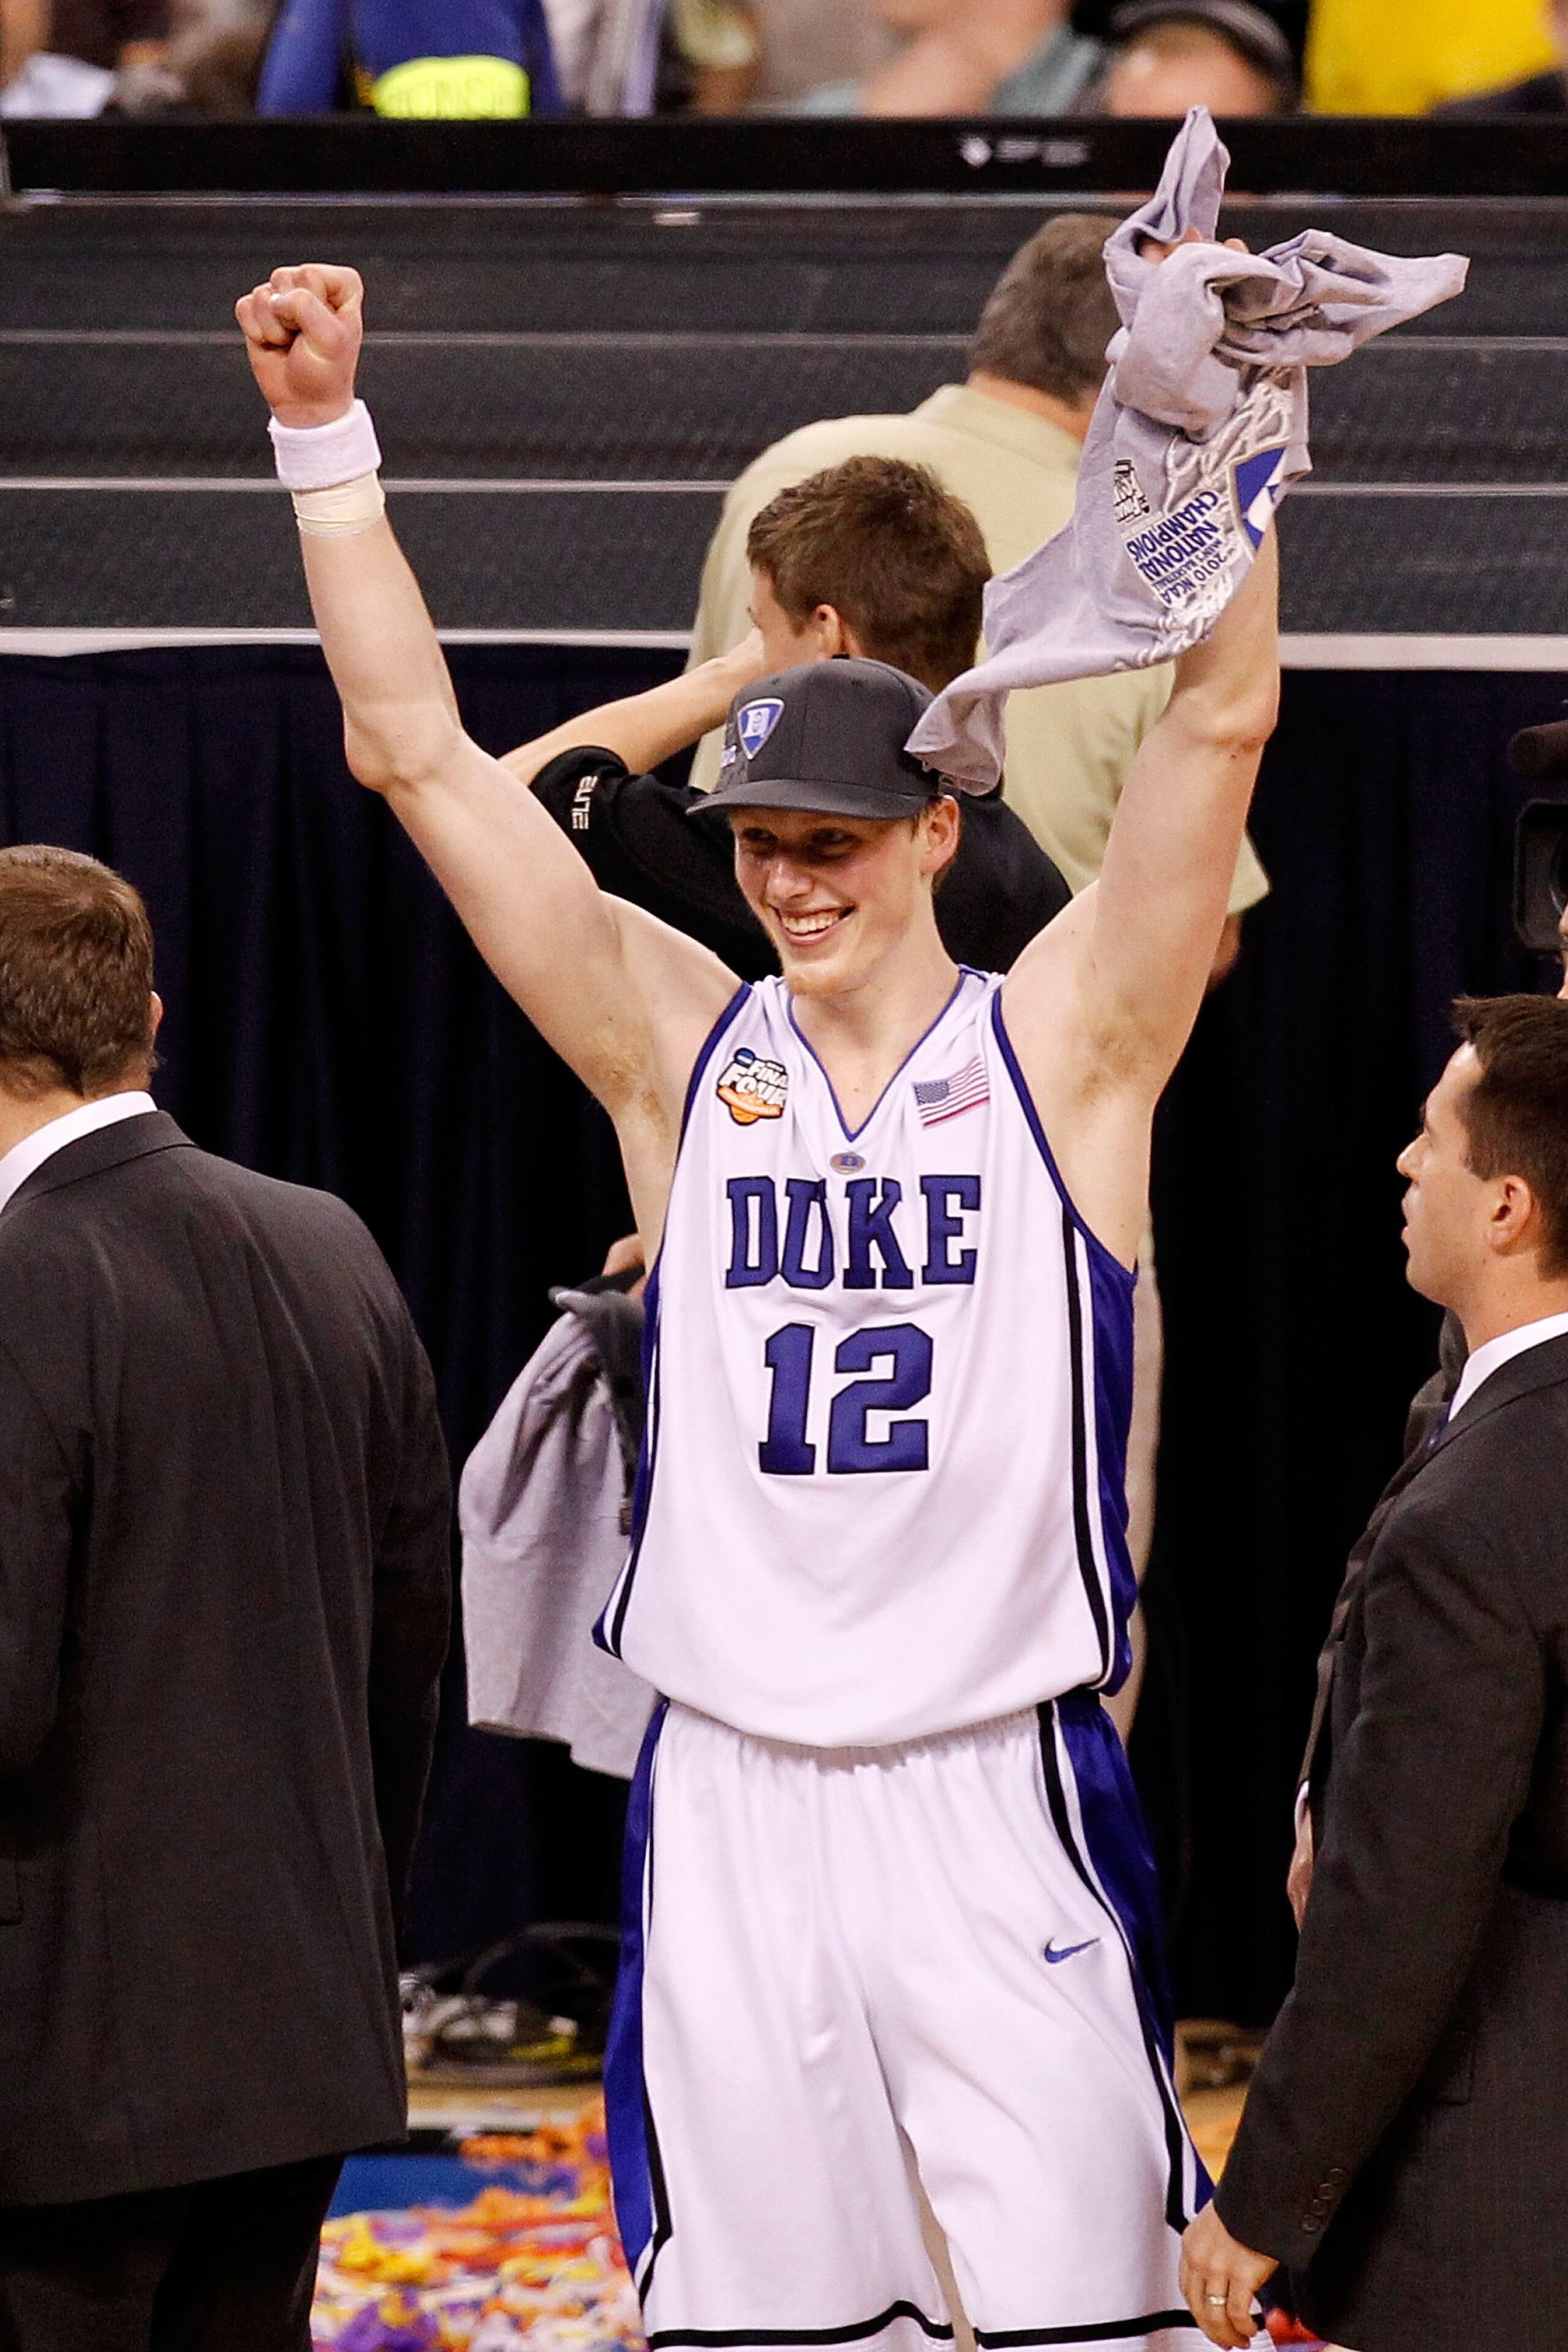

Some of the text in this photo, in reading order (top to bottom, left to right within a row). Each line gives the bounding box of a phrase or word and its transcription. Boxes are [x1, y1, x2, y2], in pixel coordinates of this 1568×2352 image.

[1126, 491, 1219, 563] CHAMPIONS
[1138, 519, 1220, 581] NATIONAL
[1160, 552, 1227, 605] 2010 NCAA
[725, 1174, 981, 1290] DUKE
[758, 1322, 933, 1476] 12
